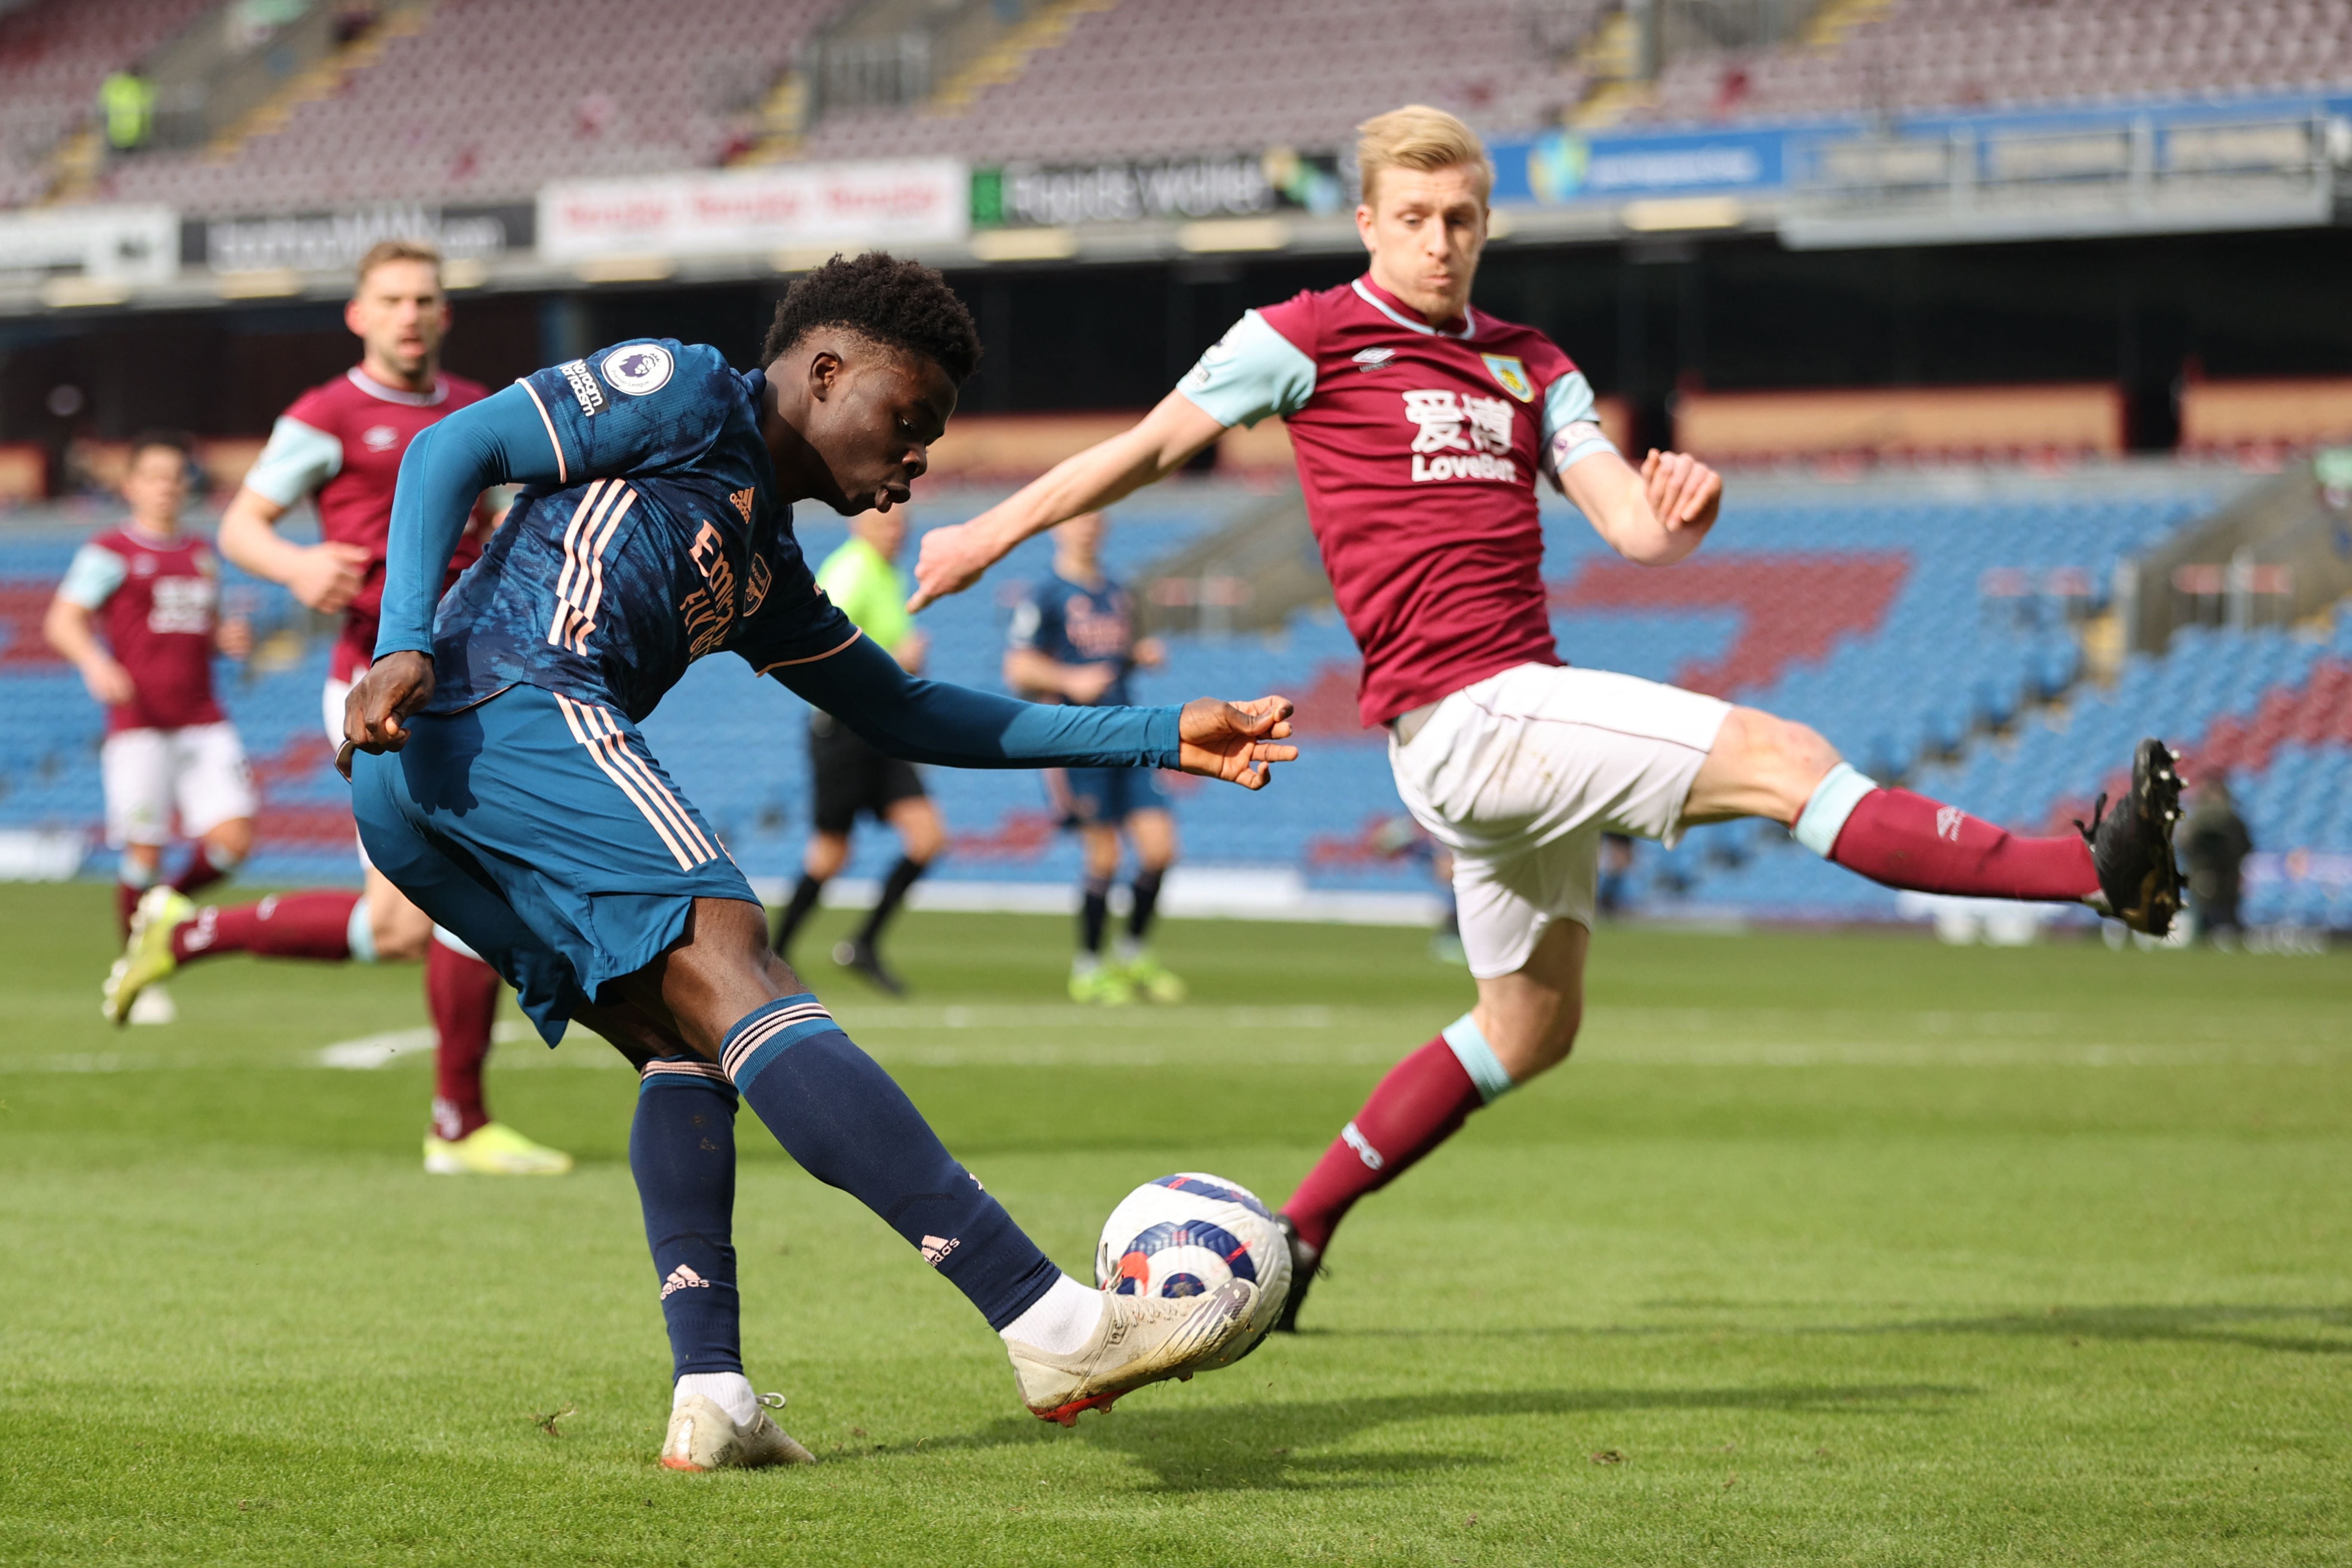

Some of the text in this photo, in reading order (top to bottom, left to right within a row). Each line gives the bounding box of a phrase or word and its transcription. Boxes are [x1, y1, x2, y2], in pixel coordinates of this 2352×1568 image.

[572, 359, 603, 407] No room
[612, 370, 628, 384] Premier
[567, 375, 595, 417] racism
[729, 493, 750, 524] adidas
[689, 519, 735, 646] Emirat
[679, 587, 717, 635] FLY
[930, 1237, 961, 1267] idas
[660, 1279, 710, 1300] adidas
